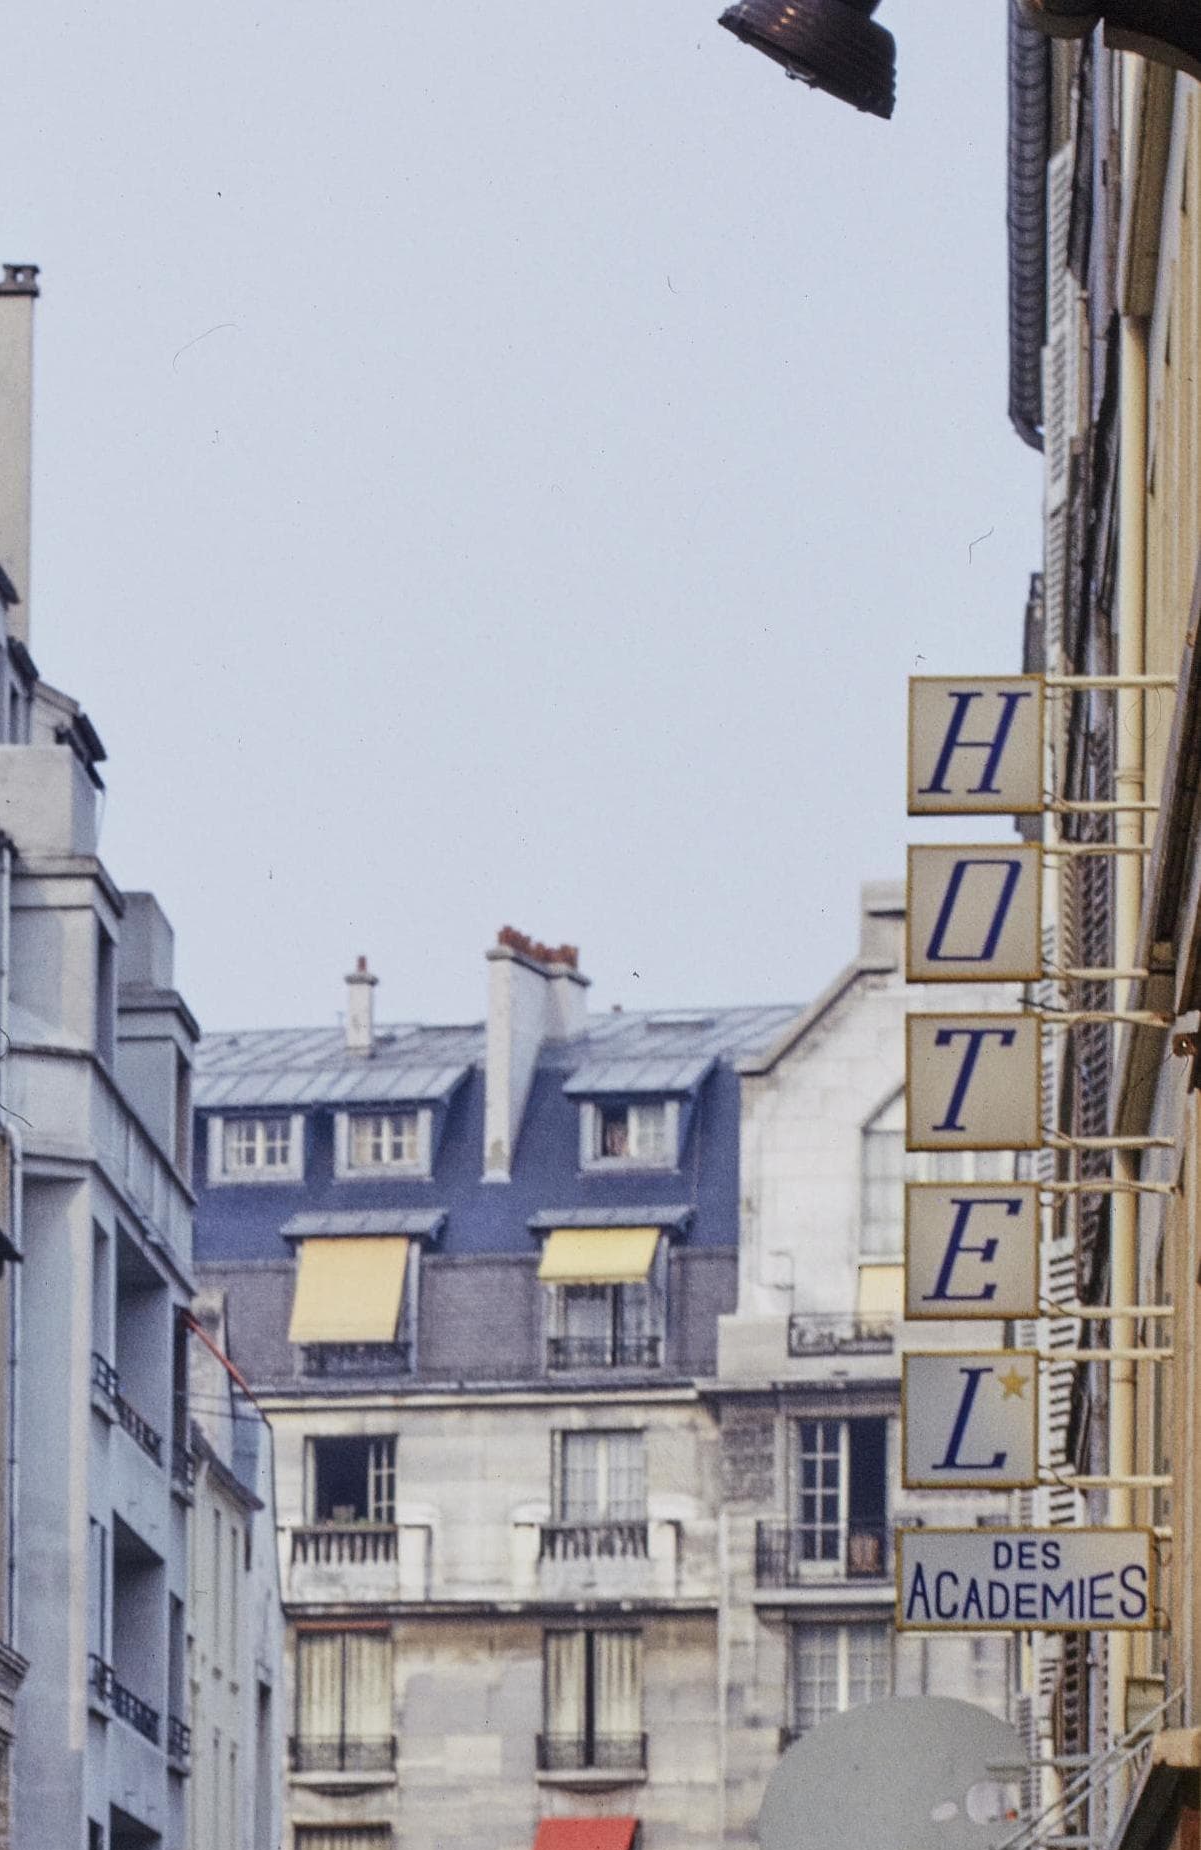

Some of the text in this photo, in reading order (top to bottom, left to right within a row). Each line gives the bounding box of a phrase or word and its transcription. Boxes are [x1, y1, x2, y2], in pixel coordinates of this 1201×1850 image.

[917, 691, 1033, 1471] HOTEL
[993, 1540, 1061, 1571] DES
[905, 1561, 1148, 1620] ACADEMIES
